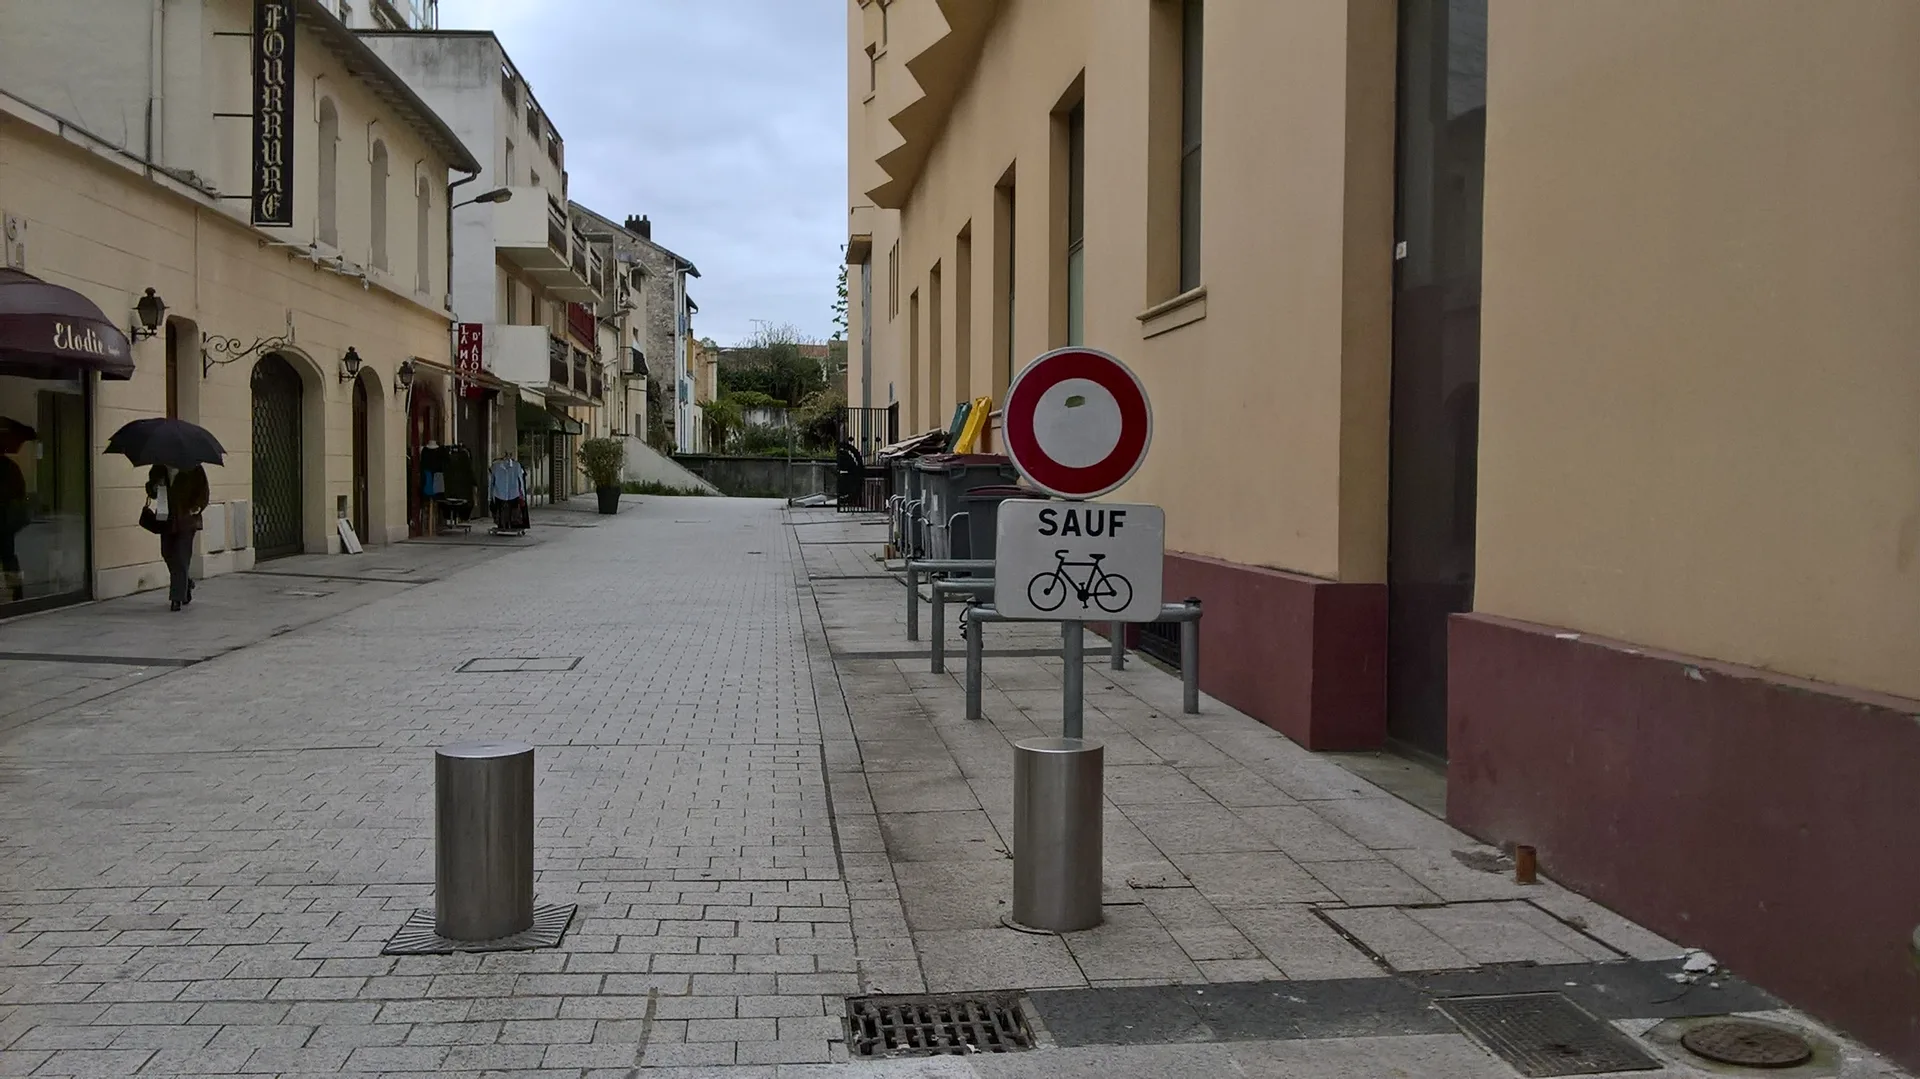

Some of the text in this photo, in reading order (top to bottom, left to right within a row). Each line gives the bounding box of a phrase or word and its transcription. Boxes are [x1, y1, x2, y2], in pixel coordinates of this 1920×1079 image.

[261, 4, 287, 219] FOURRURE
[53, 322, 104, 355] Elodie
[460, 325, 469, 397] LA MALE
[1038, 508, 1127, 537] SAUF
